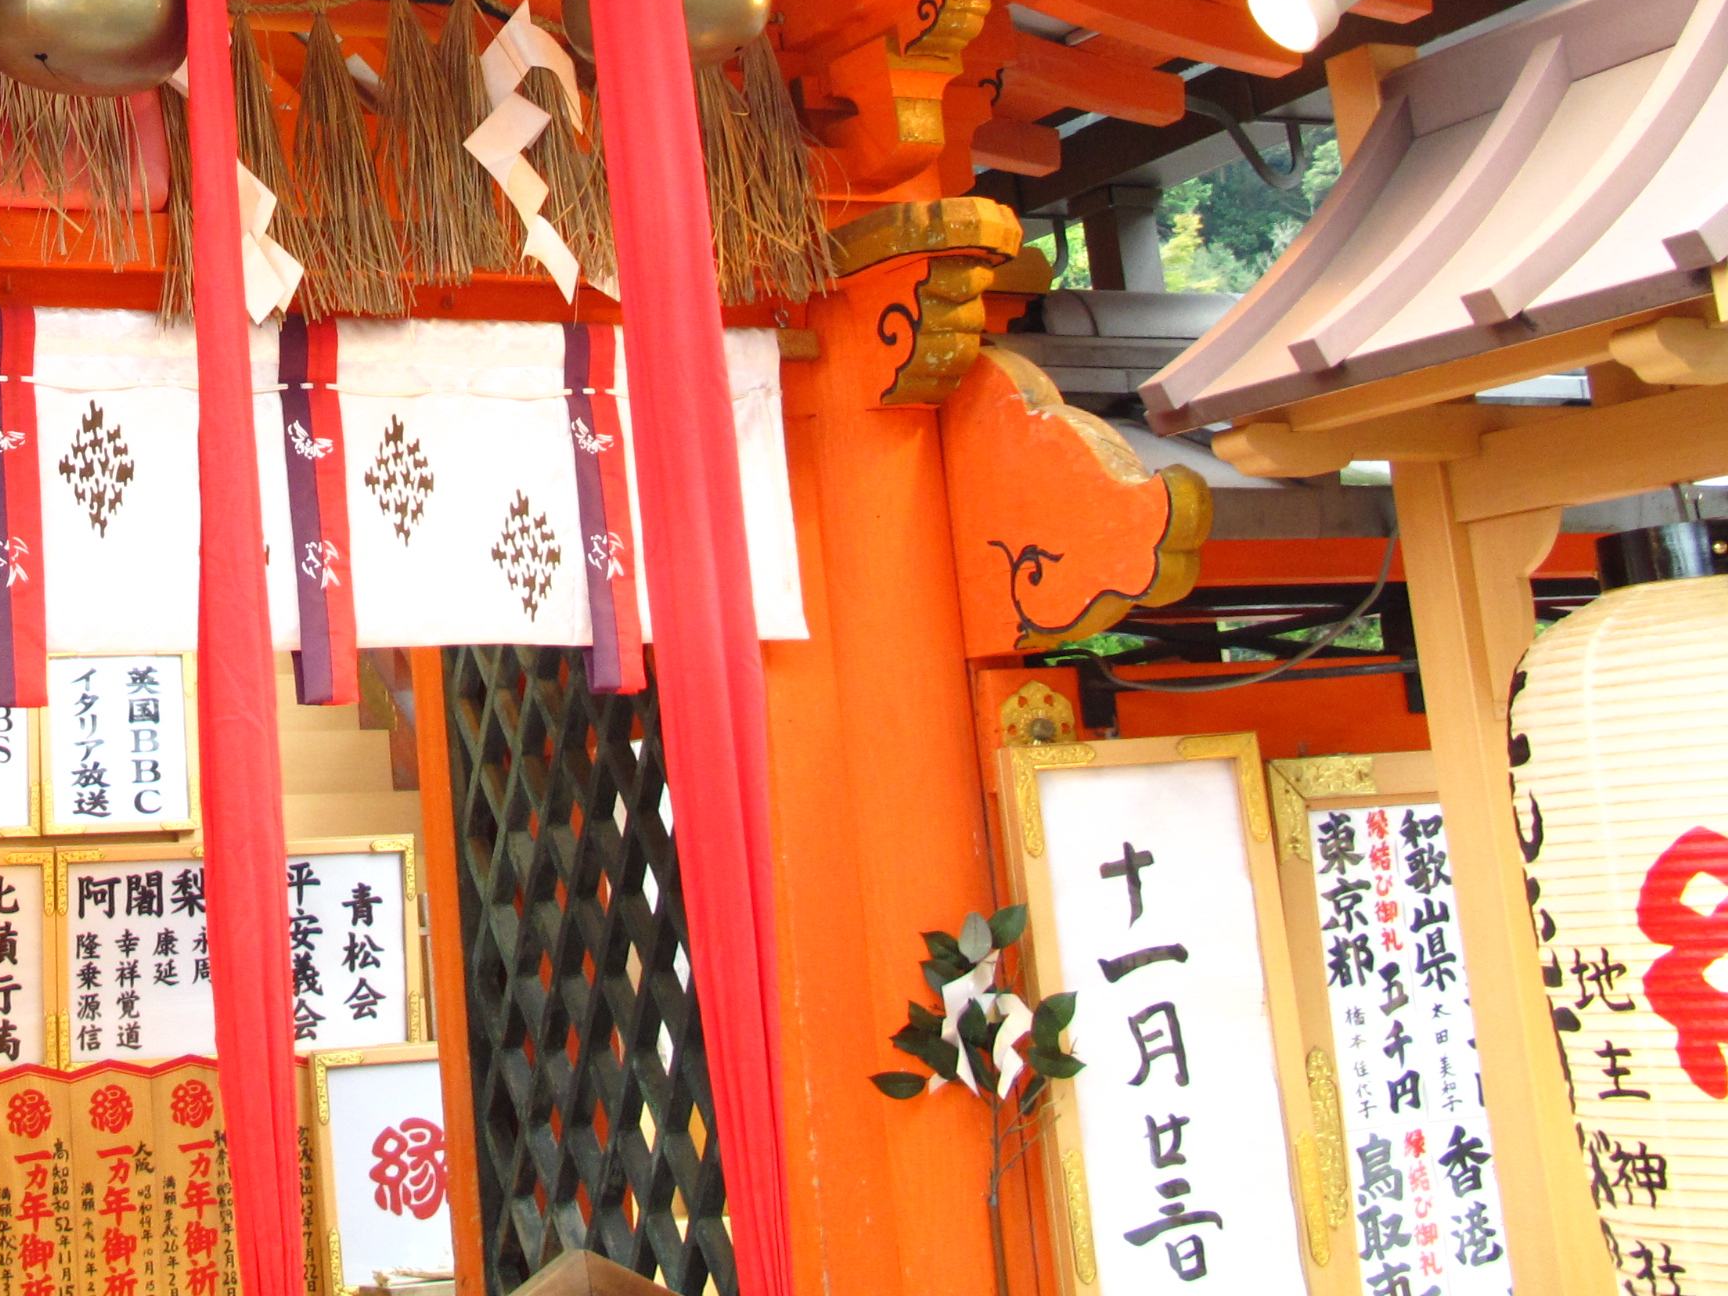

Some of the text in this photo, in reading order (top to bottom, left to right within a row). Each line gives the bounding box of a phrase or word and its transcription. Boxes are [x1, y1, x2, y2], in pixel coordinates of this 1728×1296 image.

[72, 668, 112, 818] イタリア放送
[126, 665, 163, 814] 英国BBC
[341, 882, 387, 1020] 青松会
[1318, 811, 1374, 987] 東京都
[1366, 809, 1403, 952] 縁結び御礼
[1400, 809, 1456, 991] 和歌山県
[153, 929, 180, 987] 康延
[1379, 962, 1421, 1113] 五千円
[369, 1117, 448, 1220] 縁
[1570, 947, 1686, 1296] 地主神社
[1404, 1129, 1443, 1276] 縁結び御礼
[1438, 1125, 1504, 1267] 香港
